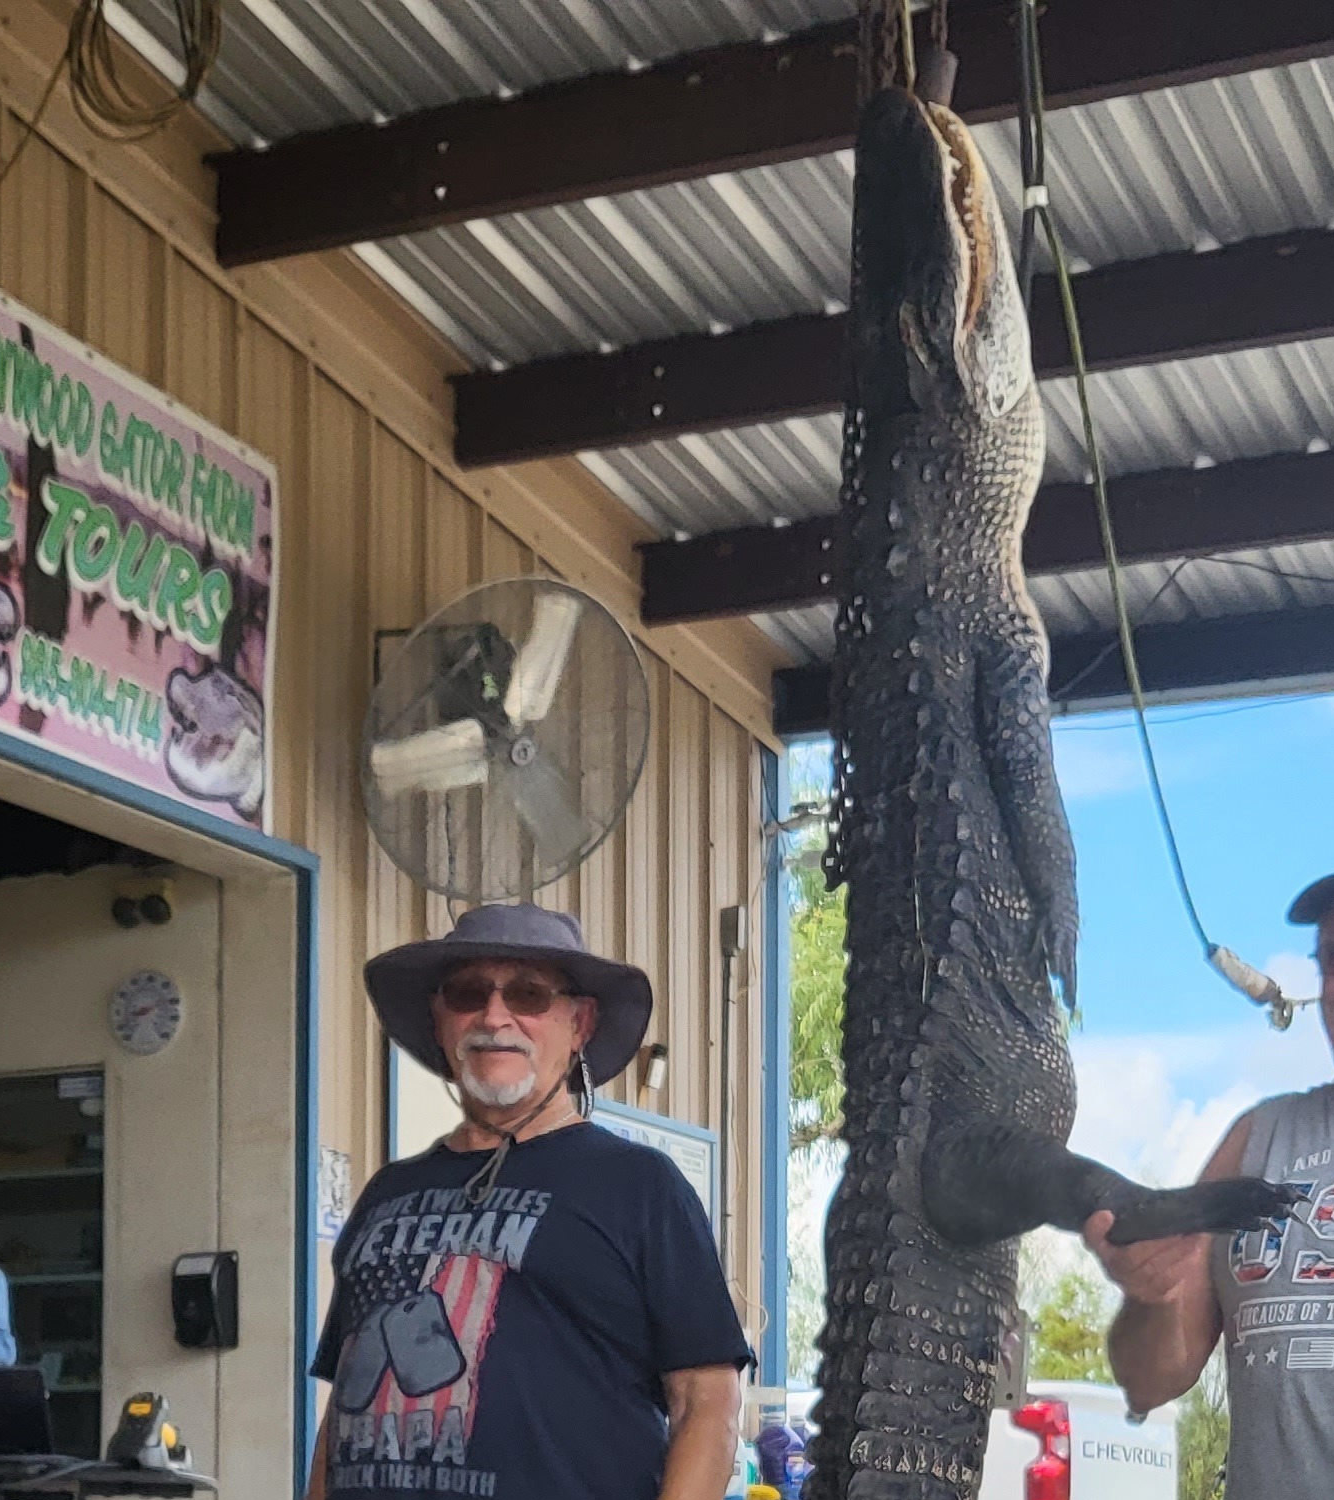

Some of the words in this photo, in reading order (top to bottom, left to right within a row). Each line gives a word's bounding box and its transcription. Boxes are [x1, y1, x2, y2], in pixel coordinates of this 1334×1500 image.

[99, 401, 185, 516] GATOR
[41, 480, 233, 646] TOURS
[1299, 1302, 1321, 1322] OF
[1082, 1440, 1173, 1469] CHEVROLET
[434, 1465, 498, 1498] BOTH
